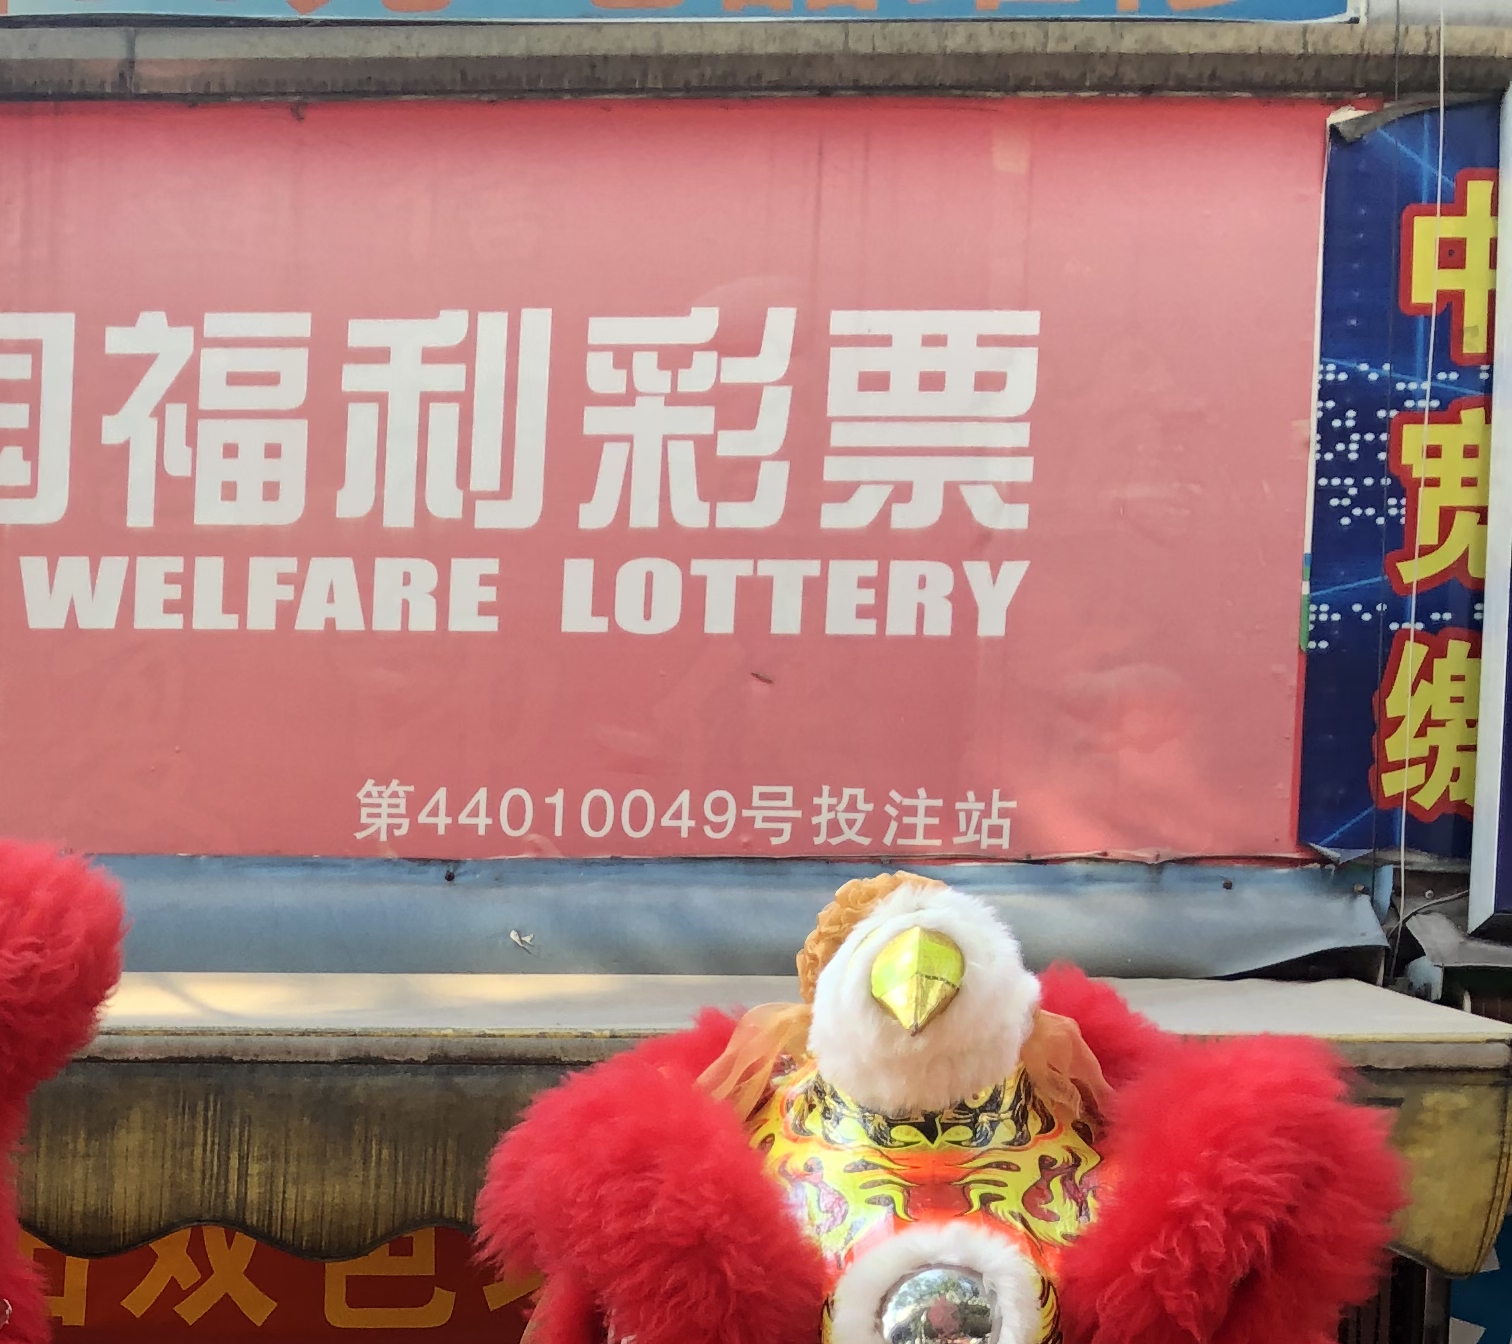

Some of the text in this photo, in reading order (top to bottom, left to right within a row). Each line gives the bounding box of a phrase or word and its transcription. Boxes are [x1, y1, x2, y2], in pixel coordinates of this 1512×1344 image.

[19, 555, 499, 632] WELFARE
[561, 557, 1031, 637] LOTTERY
[353, 777, 1018, 850] 第44010049号投注站
